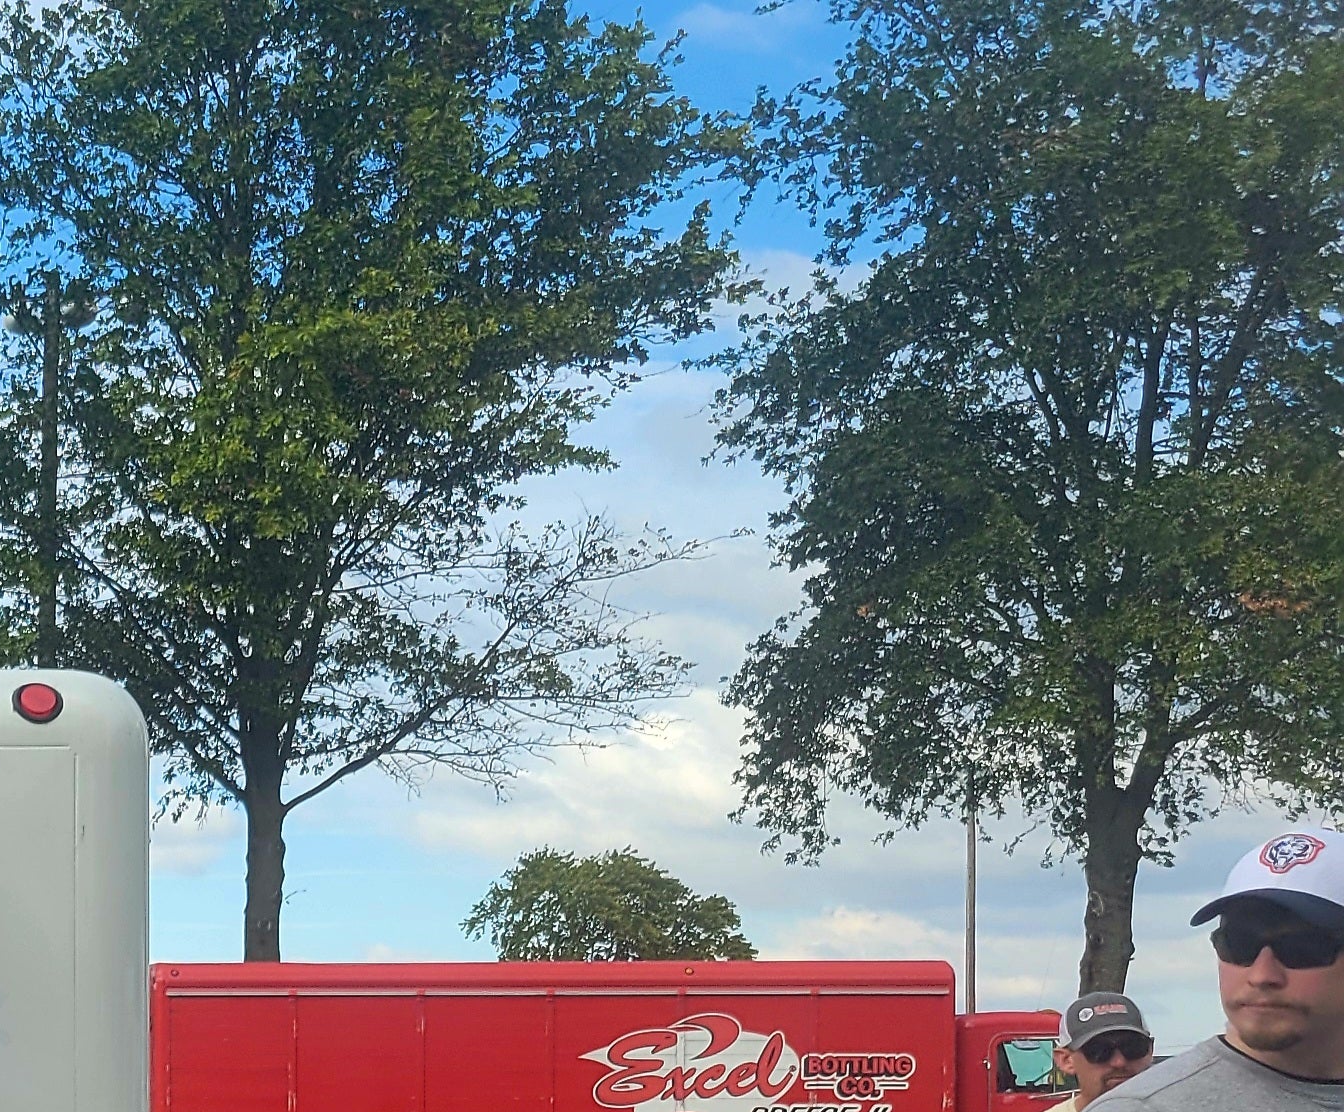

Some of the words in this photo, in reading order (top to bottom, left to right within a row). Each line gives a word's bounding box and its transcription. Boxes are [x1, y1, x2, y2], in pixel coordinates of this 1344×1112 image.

[594, 1029, 788, 1107] Excel
[804, 1055, 912, 1078] BOTTLING
[836, 1078, 880, 1099] CO.
